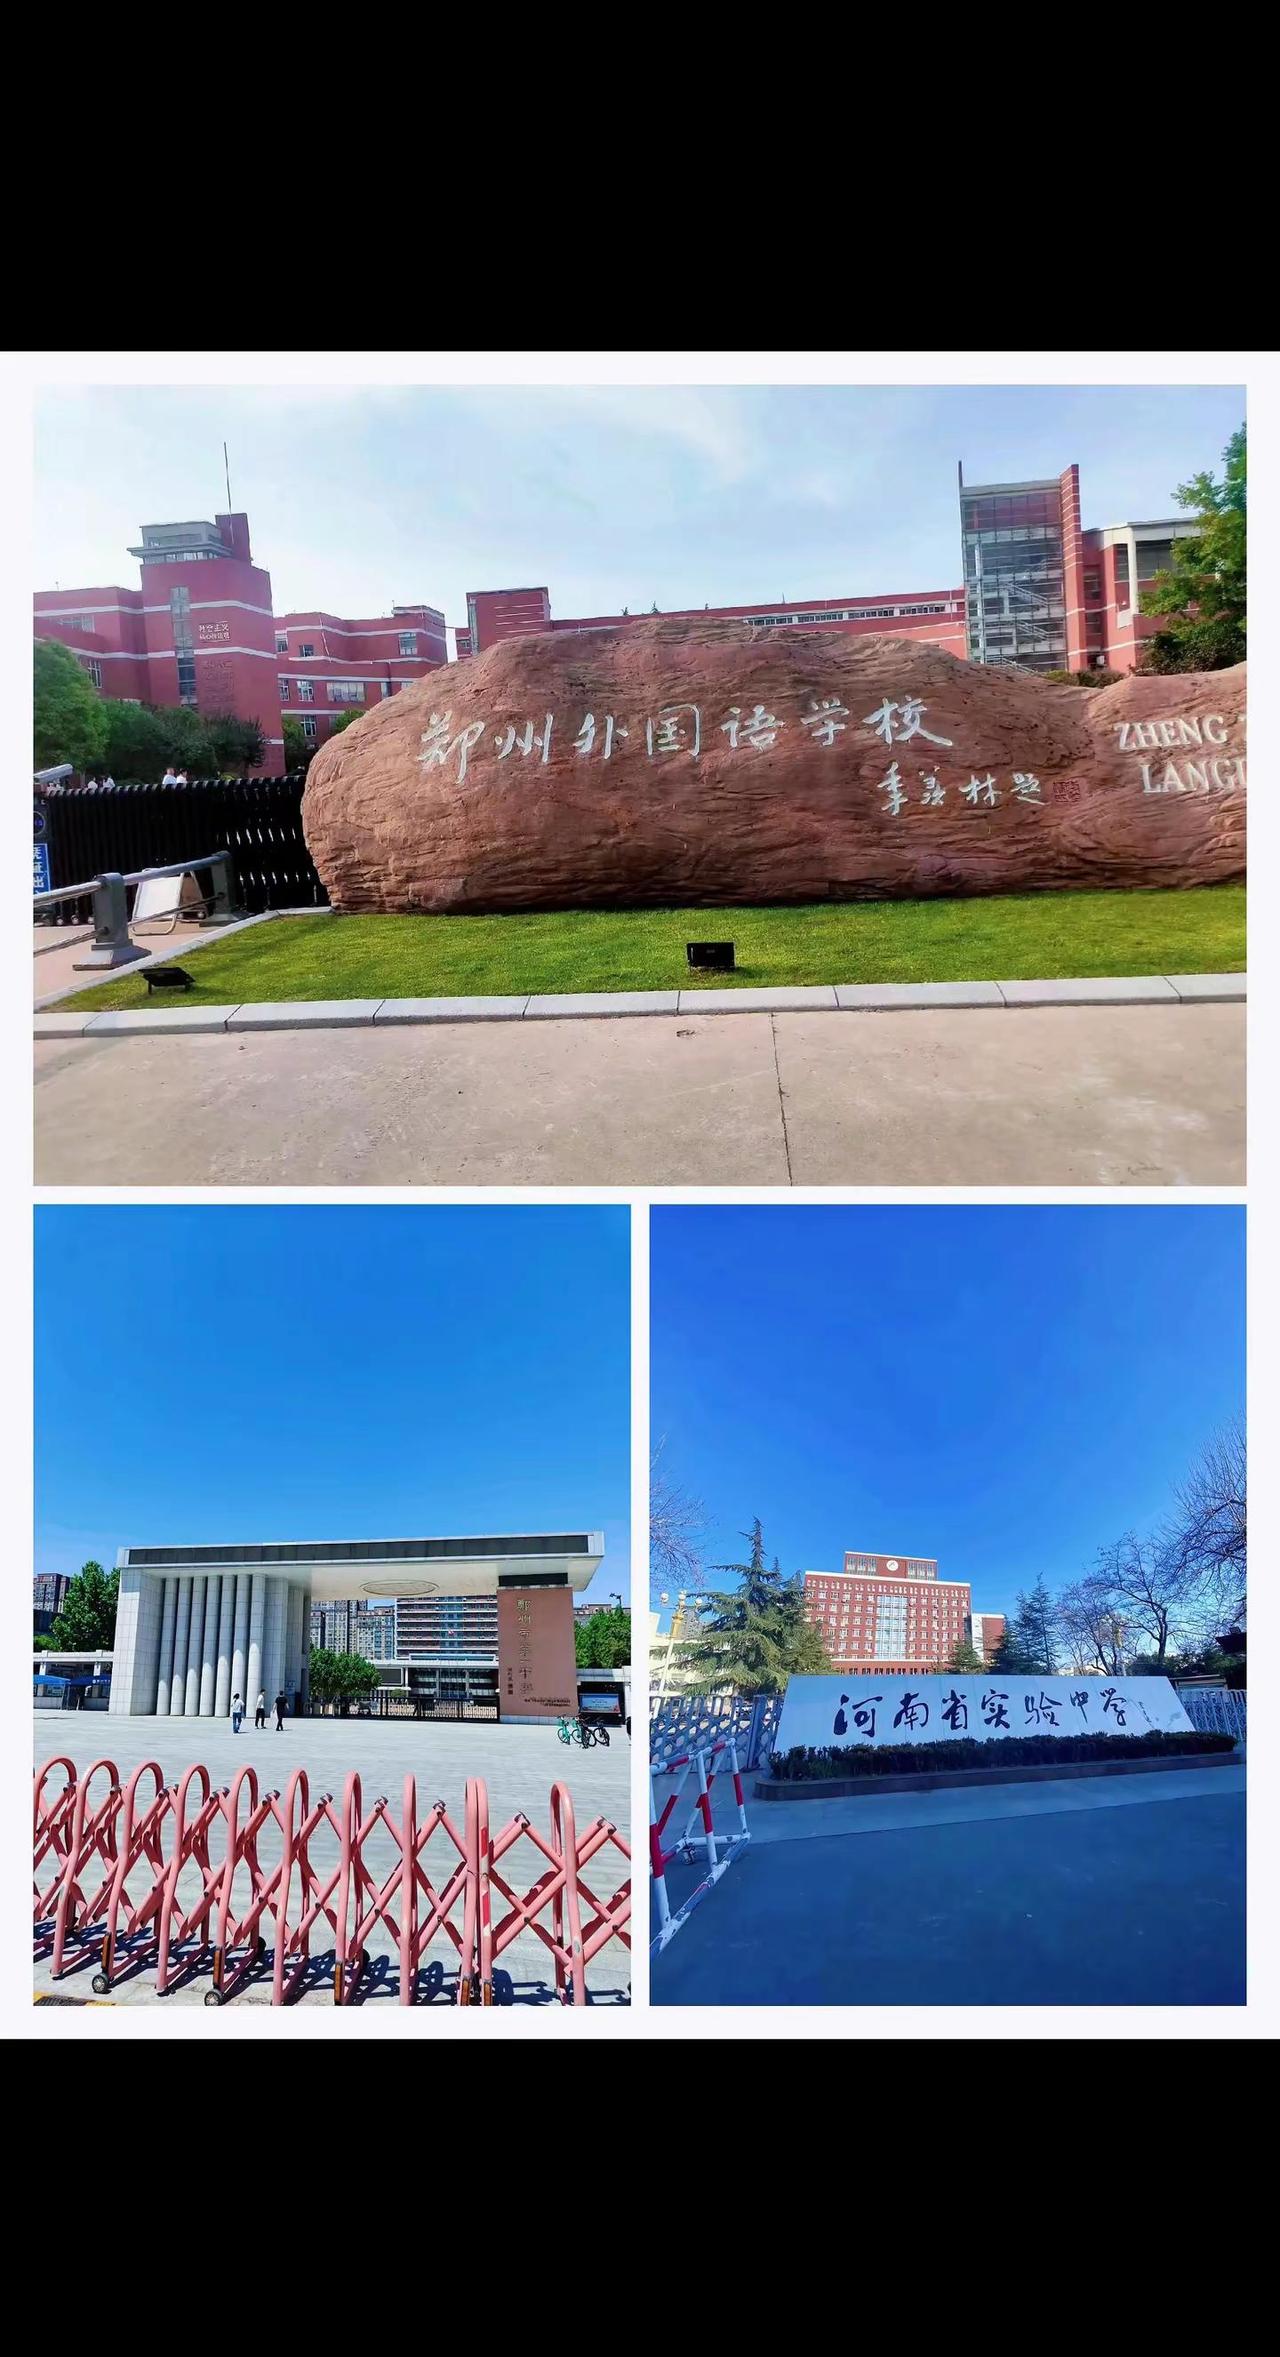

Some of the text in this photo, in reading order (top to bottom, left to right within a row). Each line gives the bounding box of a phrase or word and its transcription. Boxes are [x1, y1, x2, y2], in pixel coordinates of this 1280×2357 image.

[417, 694, 953, 785] 郑州外国语学校
[1114, 714, 1229, 750] ZHENG
[833, 1687, 1127, 1738] 河南省实验中学
